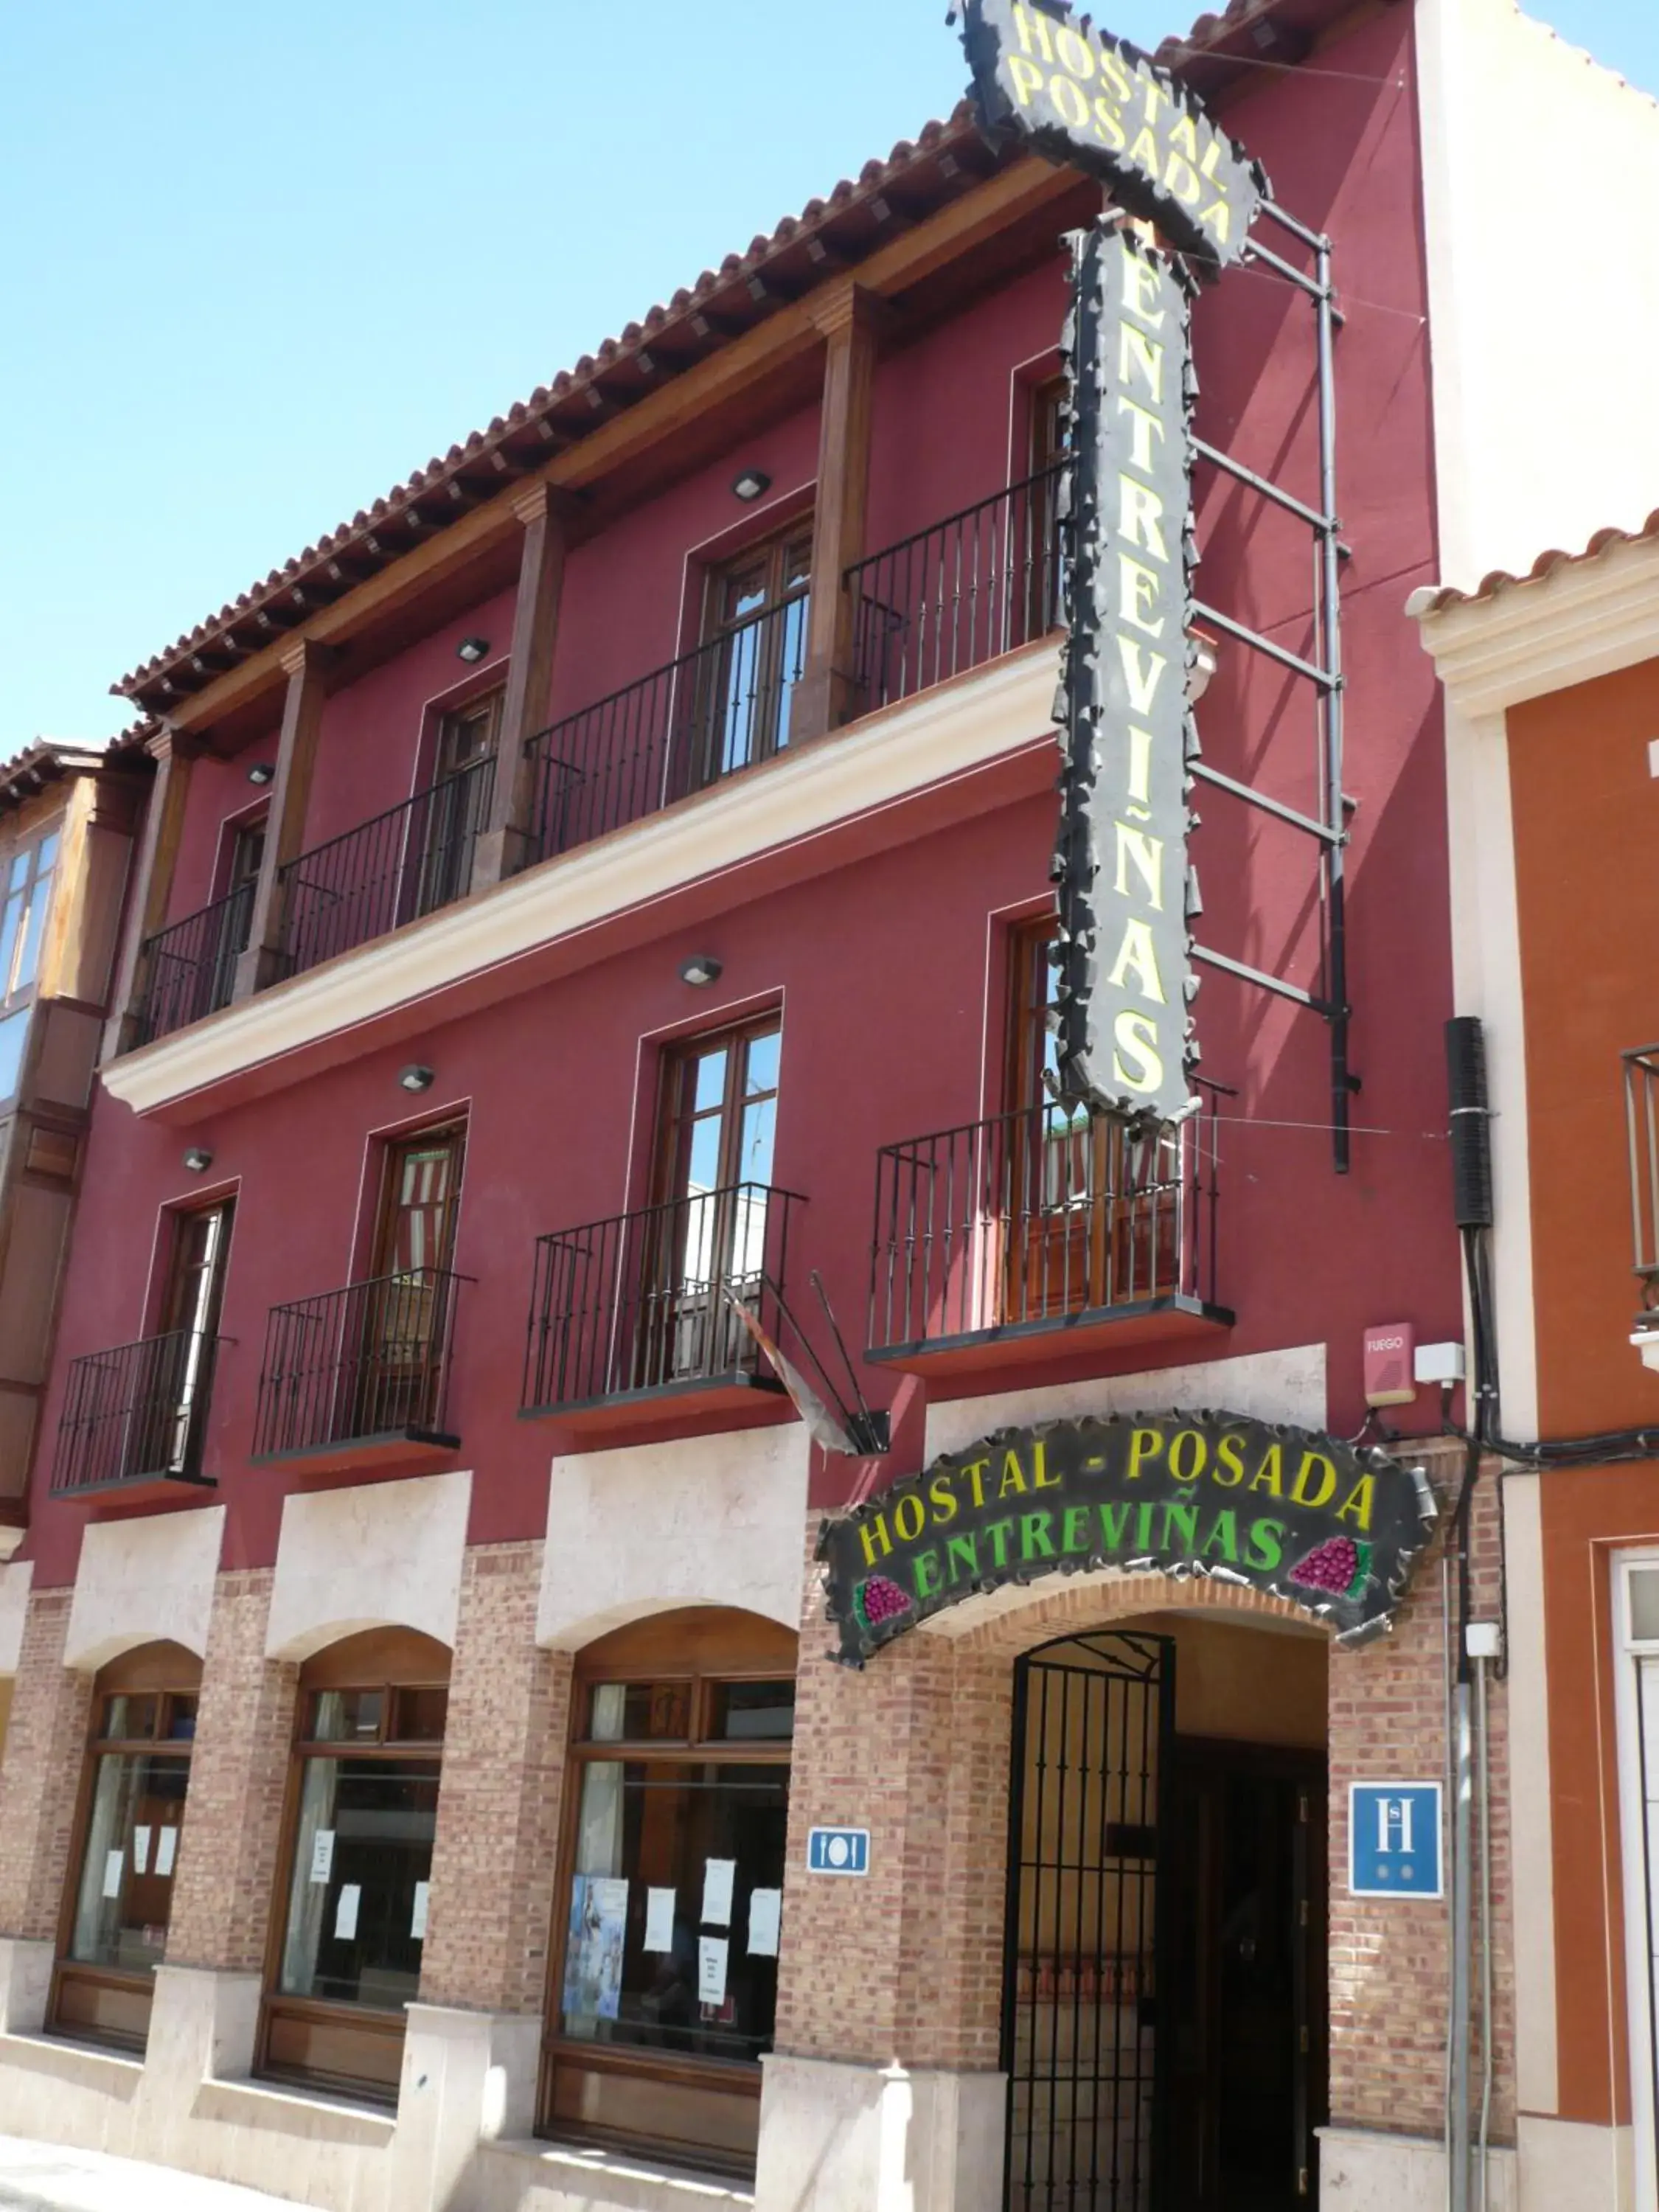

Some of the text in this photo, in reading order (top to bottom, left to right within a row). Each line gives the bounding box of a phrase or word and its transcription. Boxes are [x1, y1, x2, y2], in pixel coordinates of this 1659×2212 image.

[1007, 55, 1230, 244] POSADA
[1012, 3, 1228, 193] HOSTAL
[1107, 246, 1169, 1093] ENTREVIÑAS
[858, 1441, 1062, 1568] HOSTAL
[1127, 1428, 1377, 1531] POSADA
[913, 1485, 1286, 1599] ENTREVIÑAS
